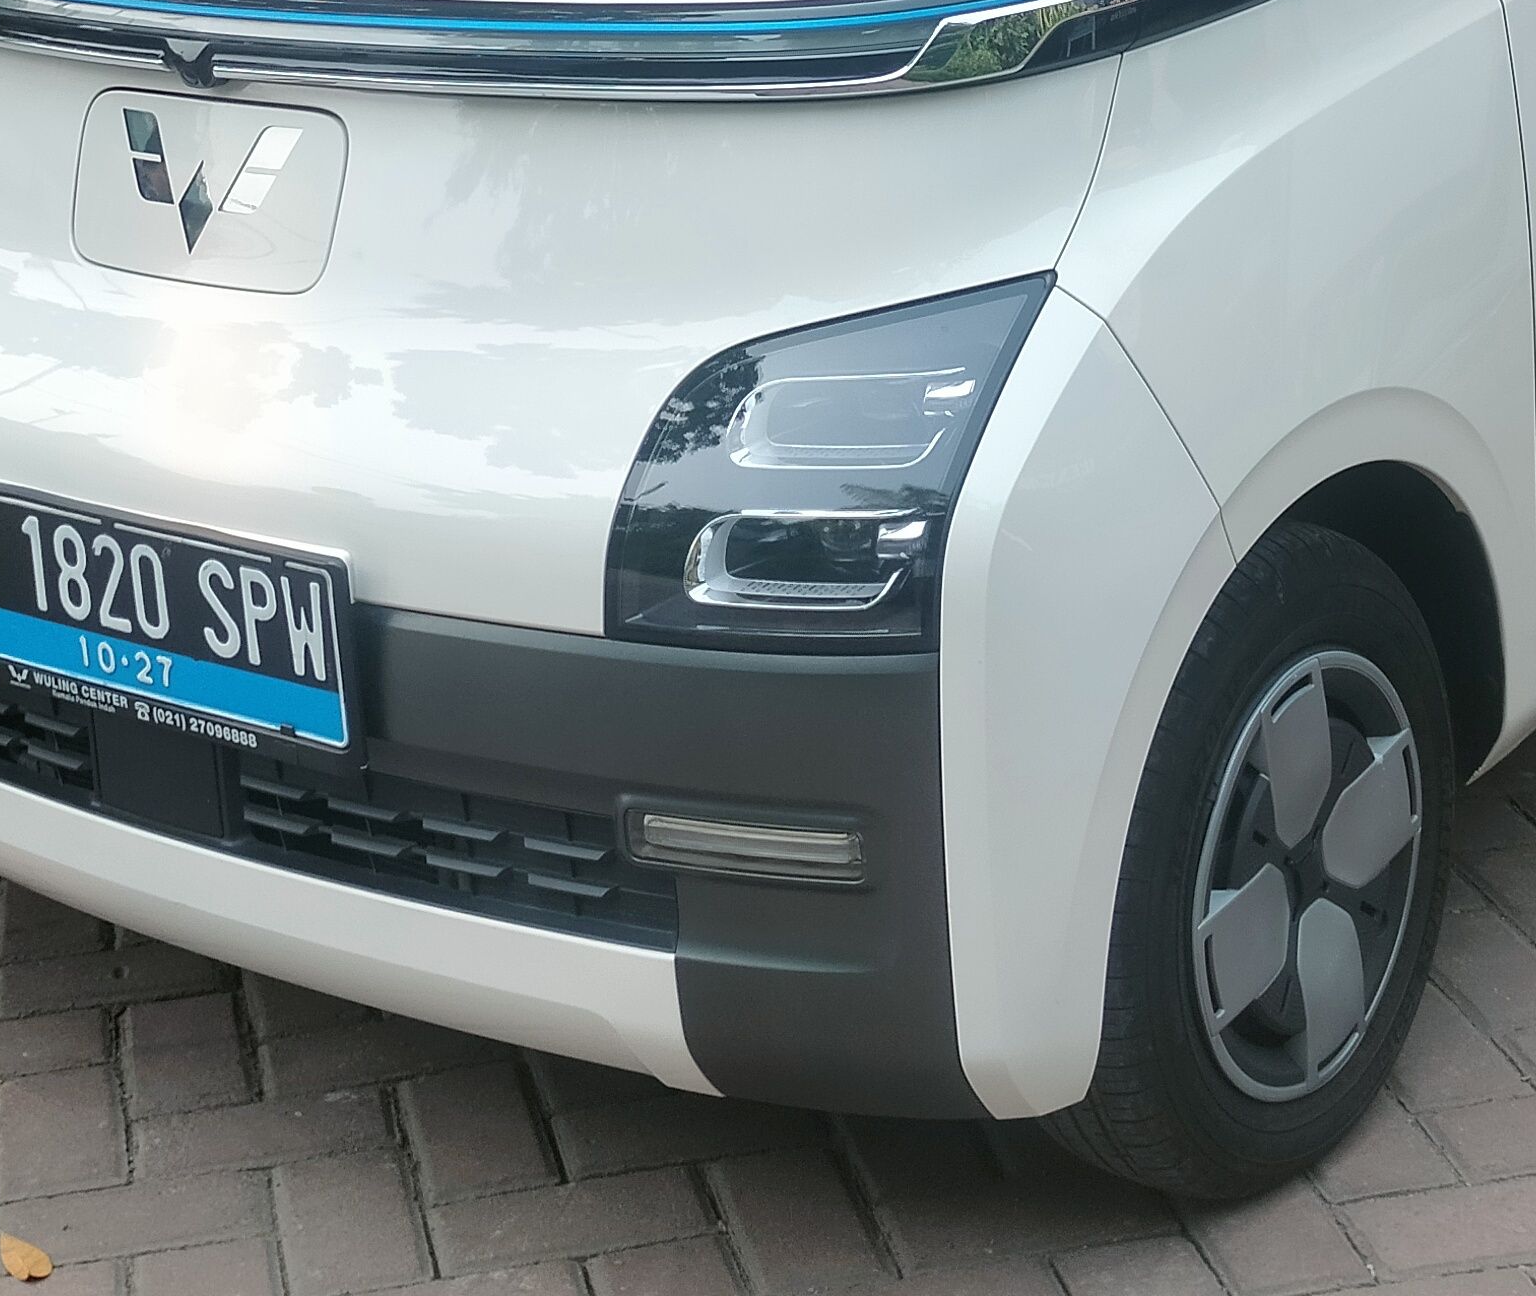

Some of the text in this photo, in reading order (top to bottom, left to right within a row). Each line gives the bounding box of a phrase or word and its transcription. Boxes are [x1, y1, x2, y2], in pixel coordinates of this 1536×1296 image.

[21, 515, 170, 639] 1820
[198, 559, 327, 682] SPW
[33, 671, 128, 708] WULING CENTER
[152, 707, 257, 748] (021) 27096888
